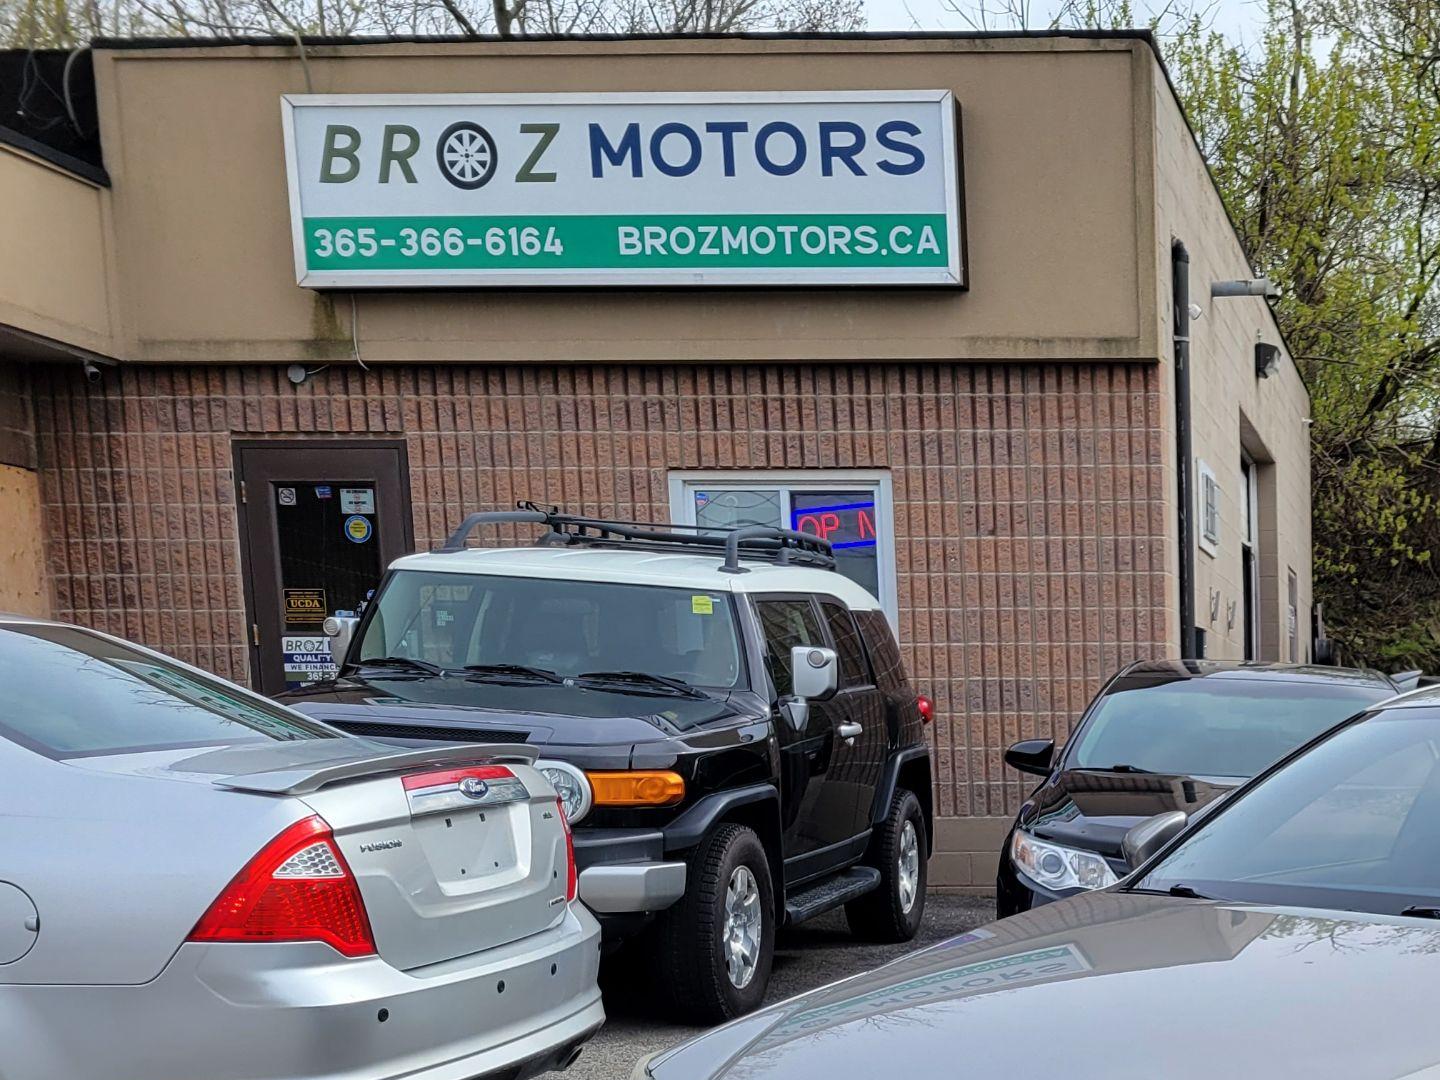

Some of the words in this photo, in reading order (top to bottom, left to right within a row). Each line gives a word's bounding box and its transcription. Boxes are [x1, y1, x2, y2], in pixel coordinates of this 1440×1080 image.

[588, 121, 926, 179] MOTORS
[313, 226, 564, 258] 365-366-6164
[617, 224, 940, 257] BROZMOTORS.CA
[290, 599, 320, 608] UCDA
